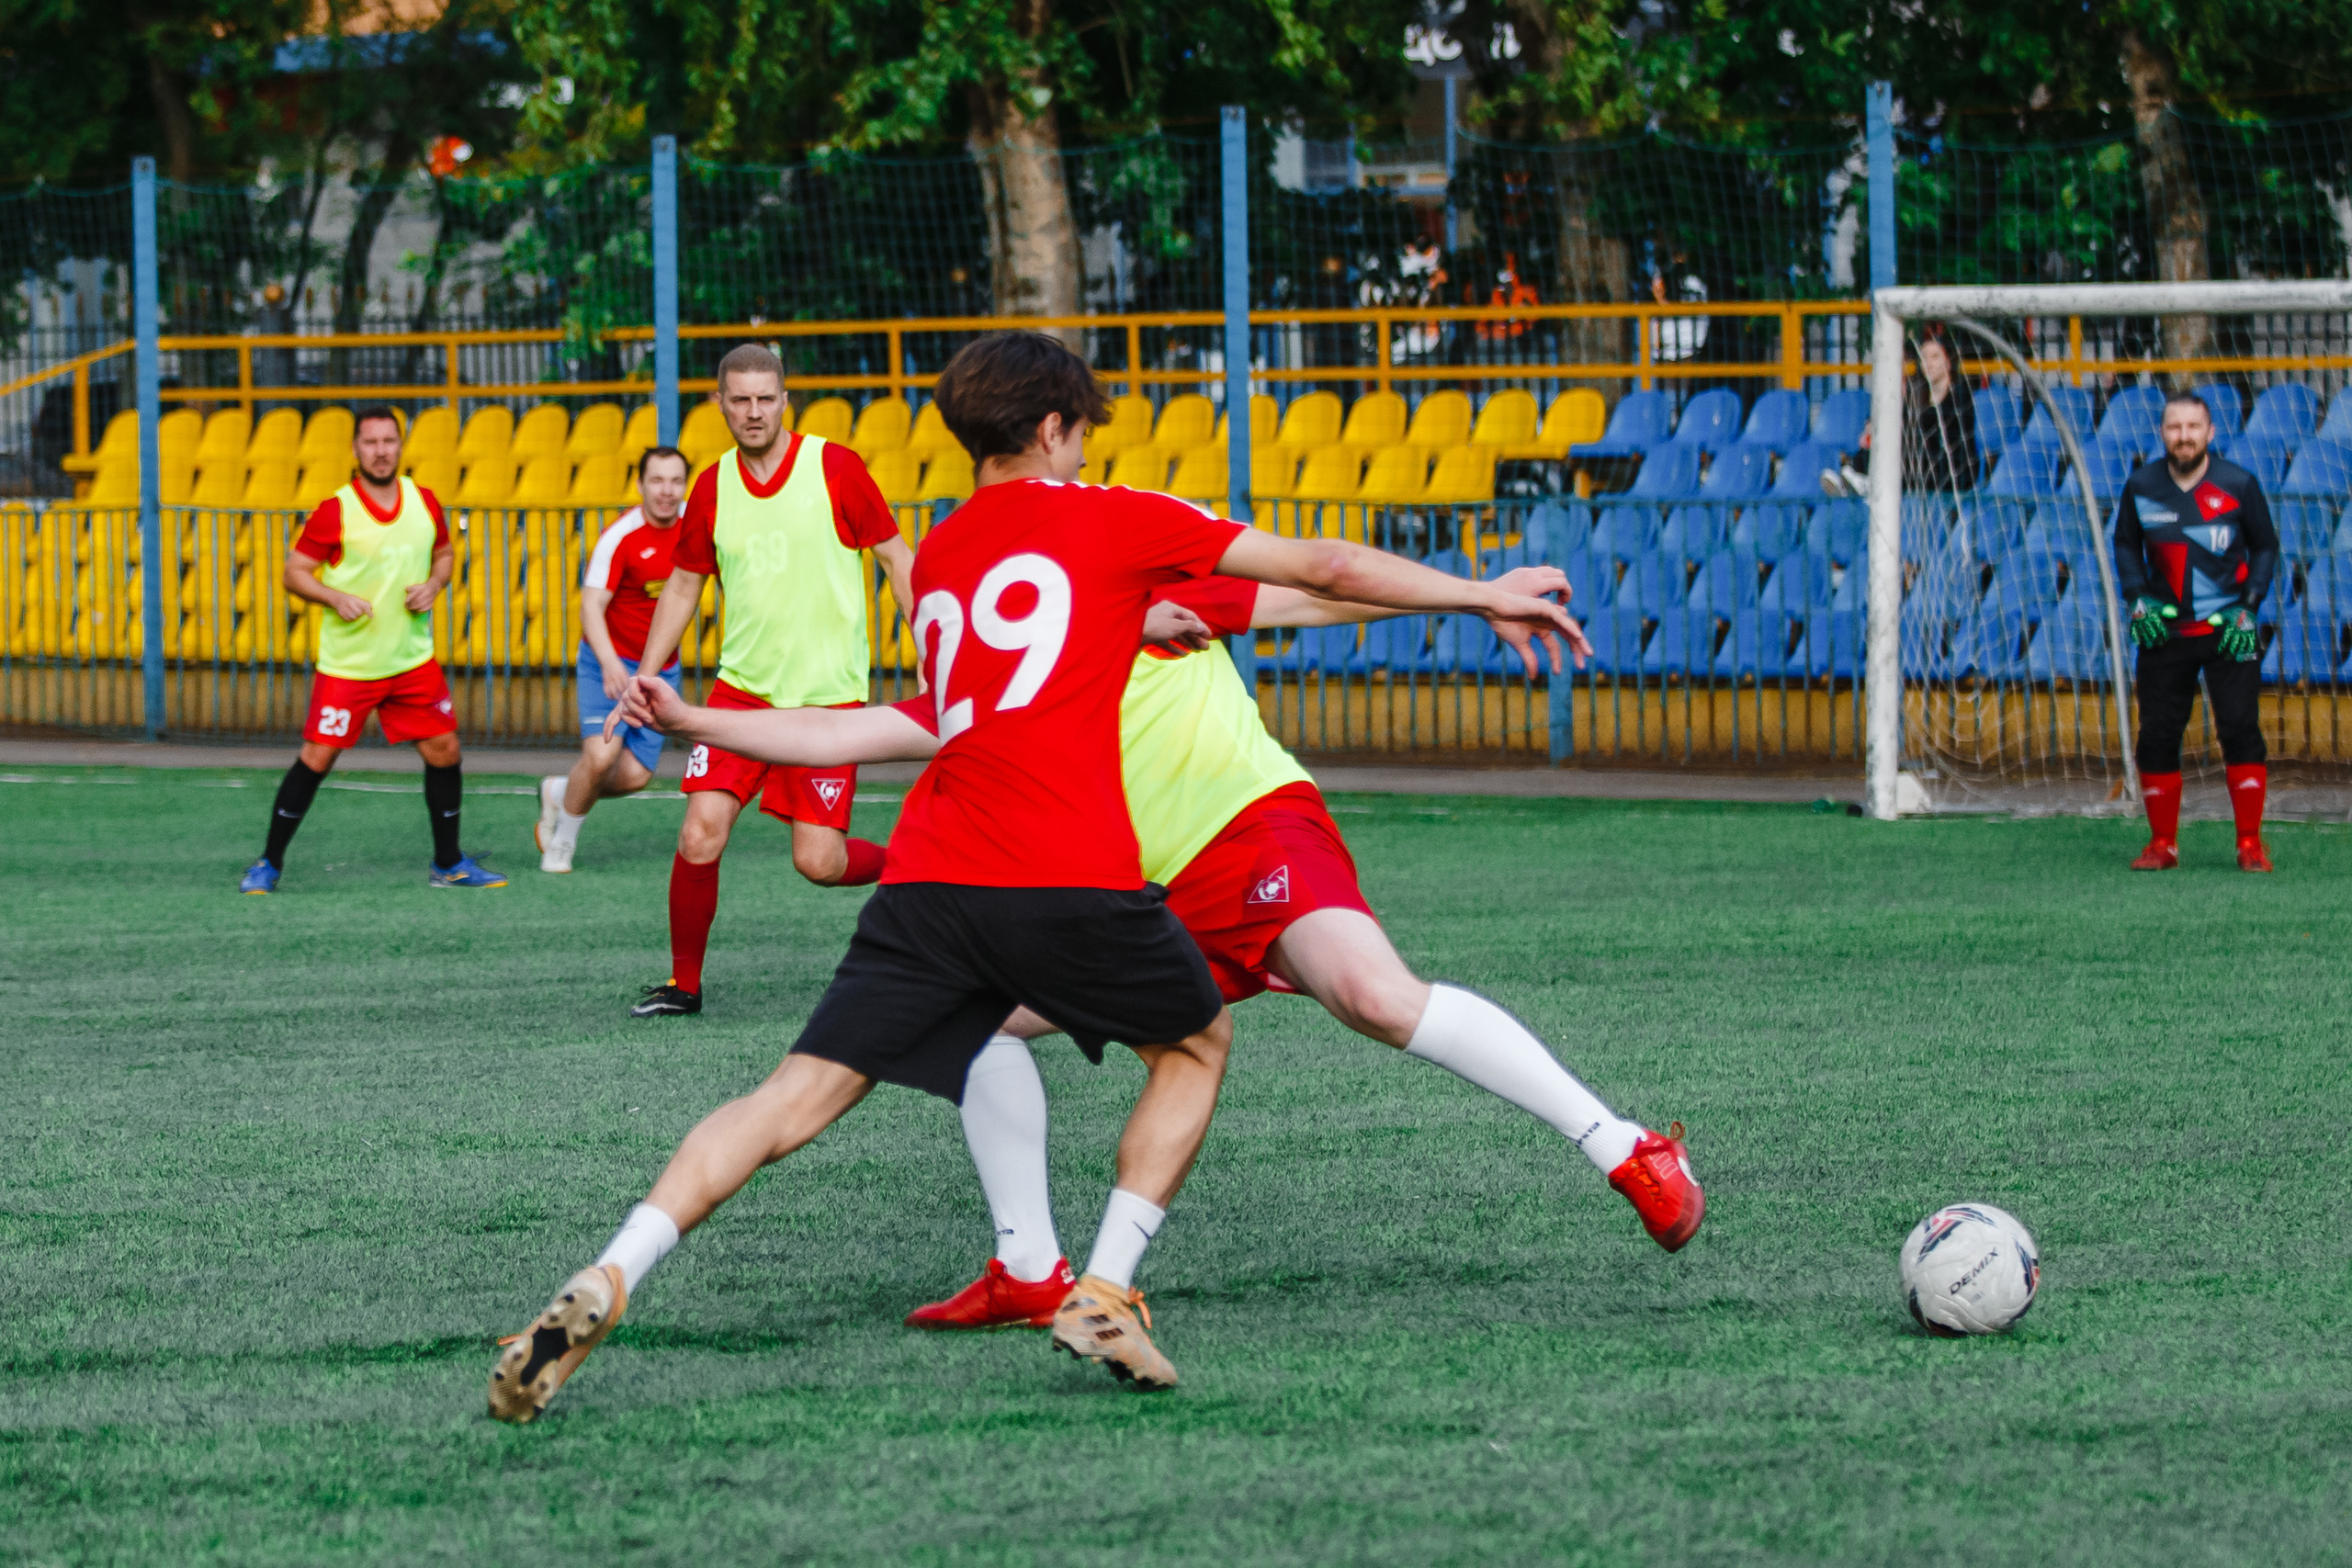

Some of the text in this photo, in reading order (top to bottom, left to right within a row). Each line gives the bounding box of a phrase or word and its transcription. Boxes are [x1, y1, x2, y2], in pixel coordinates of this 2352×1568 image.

[2210, 525, 2230, 552] 14
[913, 553, 1072, 749] 29
[318, 705, 352, 738] 23
[1948, 1247, 1998, 1295] DEMIX
